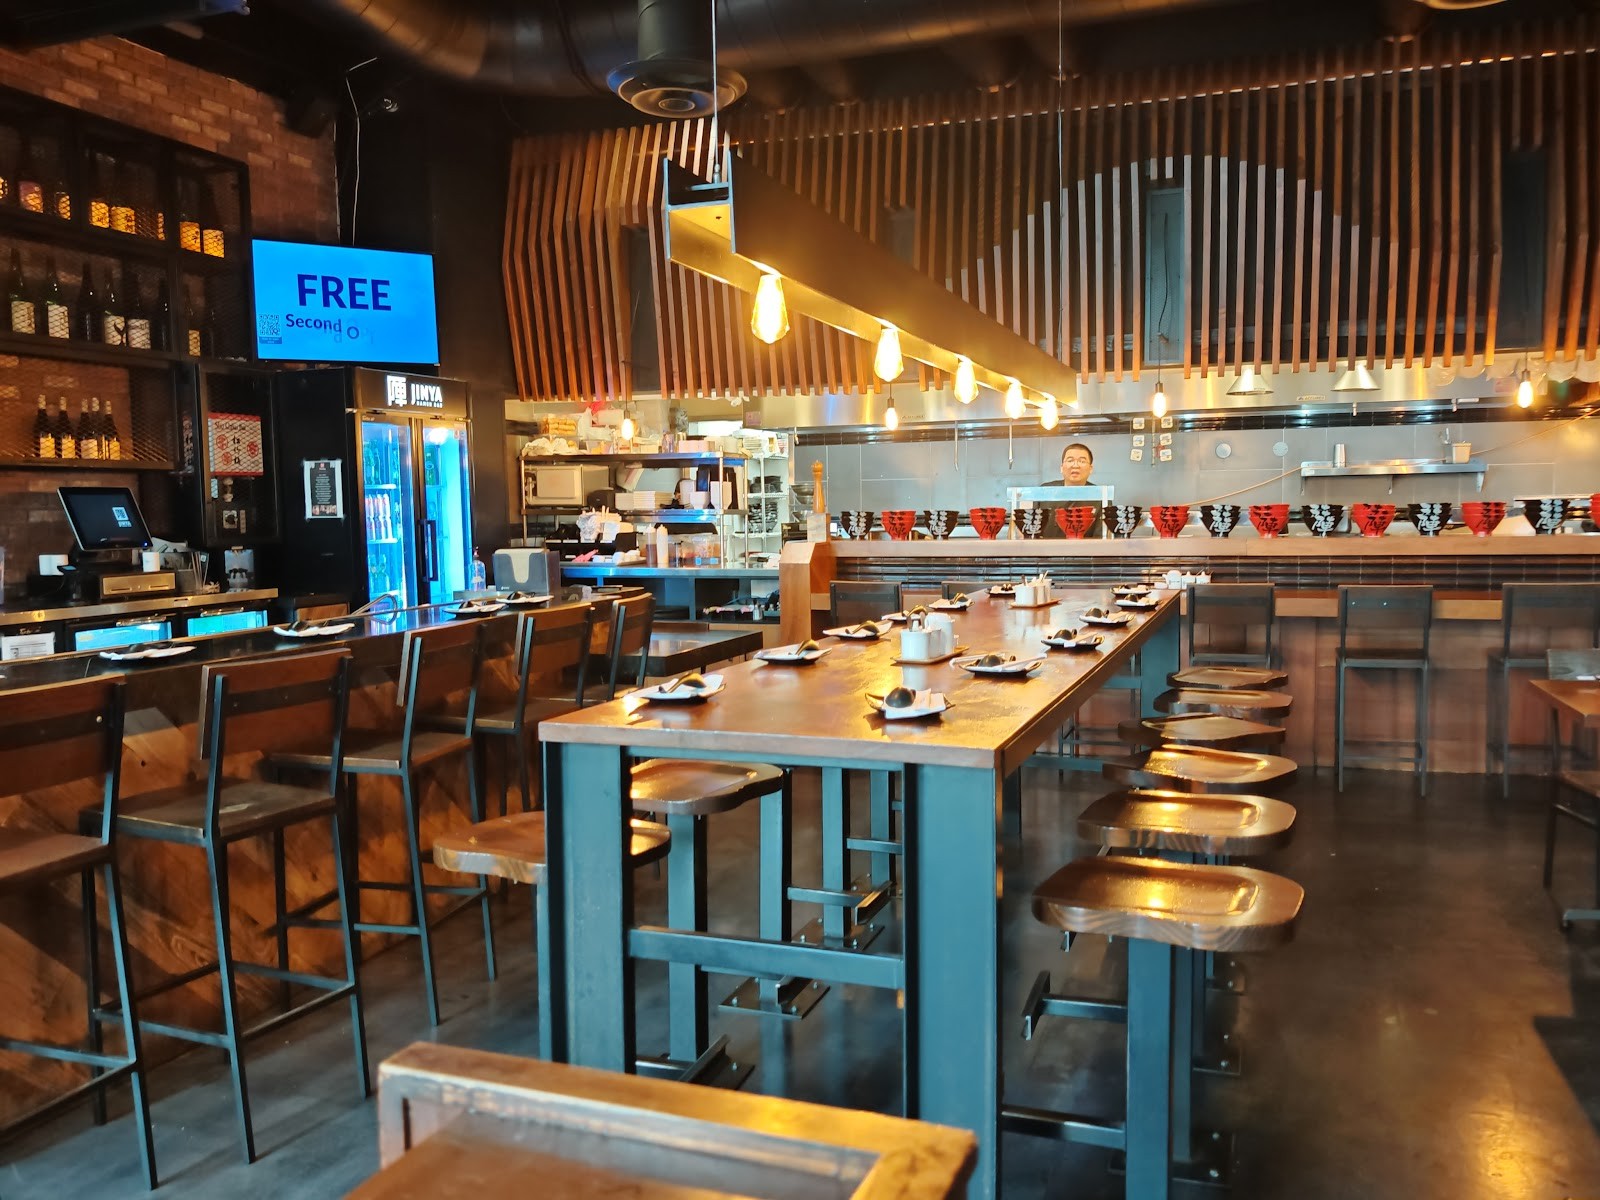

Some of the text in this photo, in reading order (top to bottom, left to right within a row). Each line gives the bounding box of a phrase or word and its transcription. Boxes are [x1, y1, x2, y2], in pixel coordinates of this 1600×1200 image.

[297, 273, 392, 311] FREE
[285, 313, 342, 333] Second
[411, 383, 443, 405] JINYA
